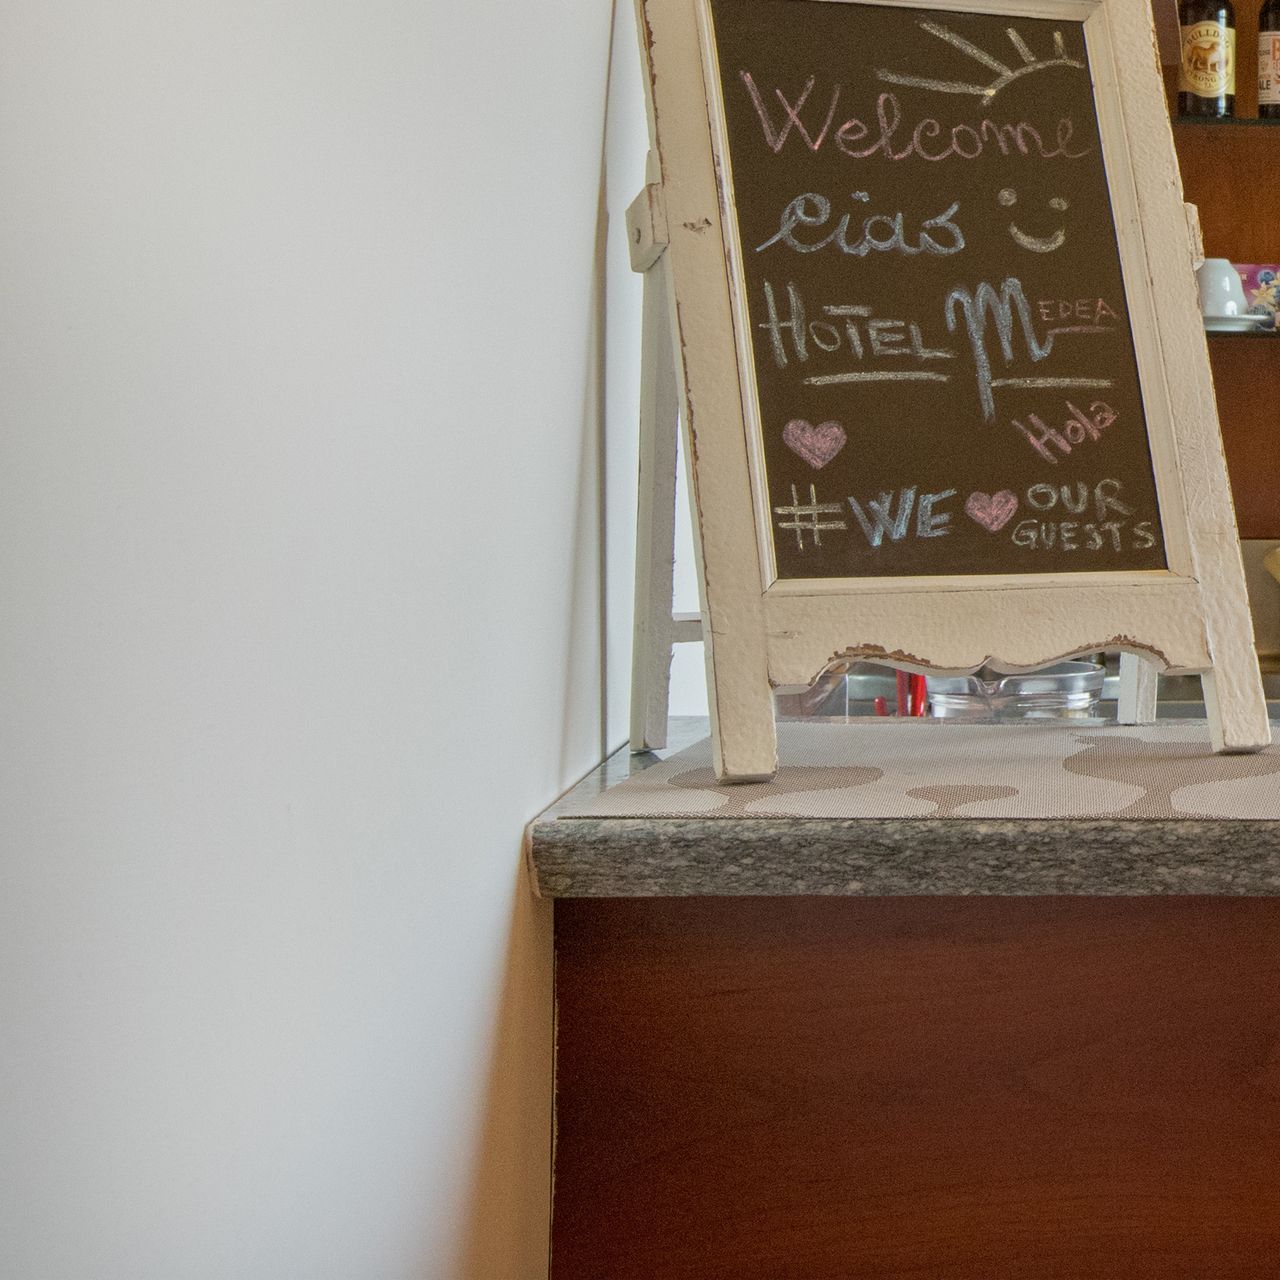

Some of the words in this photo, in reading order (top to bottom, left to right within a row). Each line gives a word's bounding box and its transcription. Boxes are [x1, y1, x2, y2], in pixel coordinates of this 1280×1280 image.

[738, 70, 1093, 161] Welcome
[755, 192, 966, 256] Ciao
[757, 277, 955, 368] HOTEL
[1011, 400, 1119, 464] Hola
[1025, 478, 1136, 517] OUR
[1009, 519, 1158, 552] GUESTS
